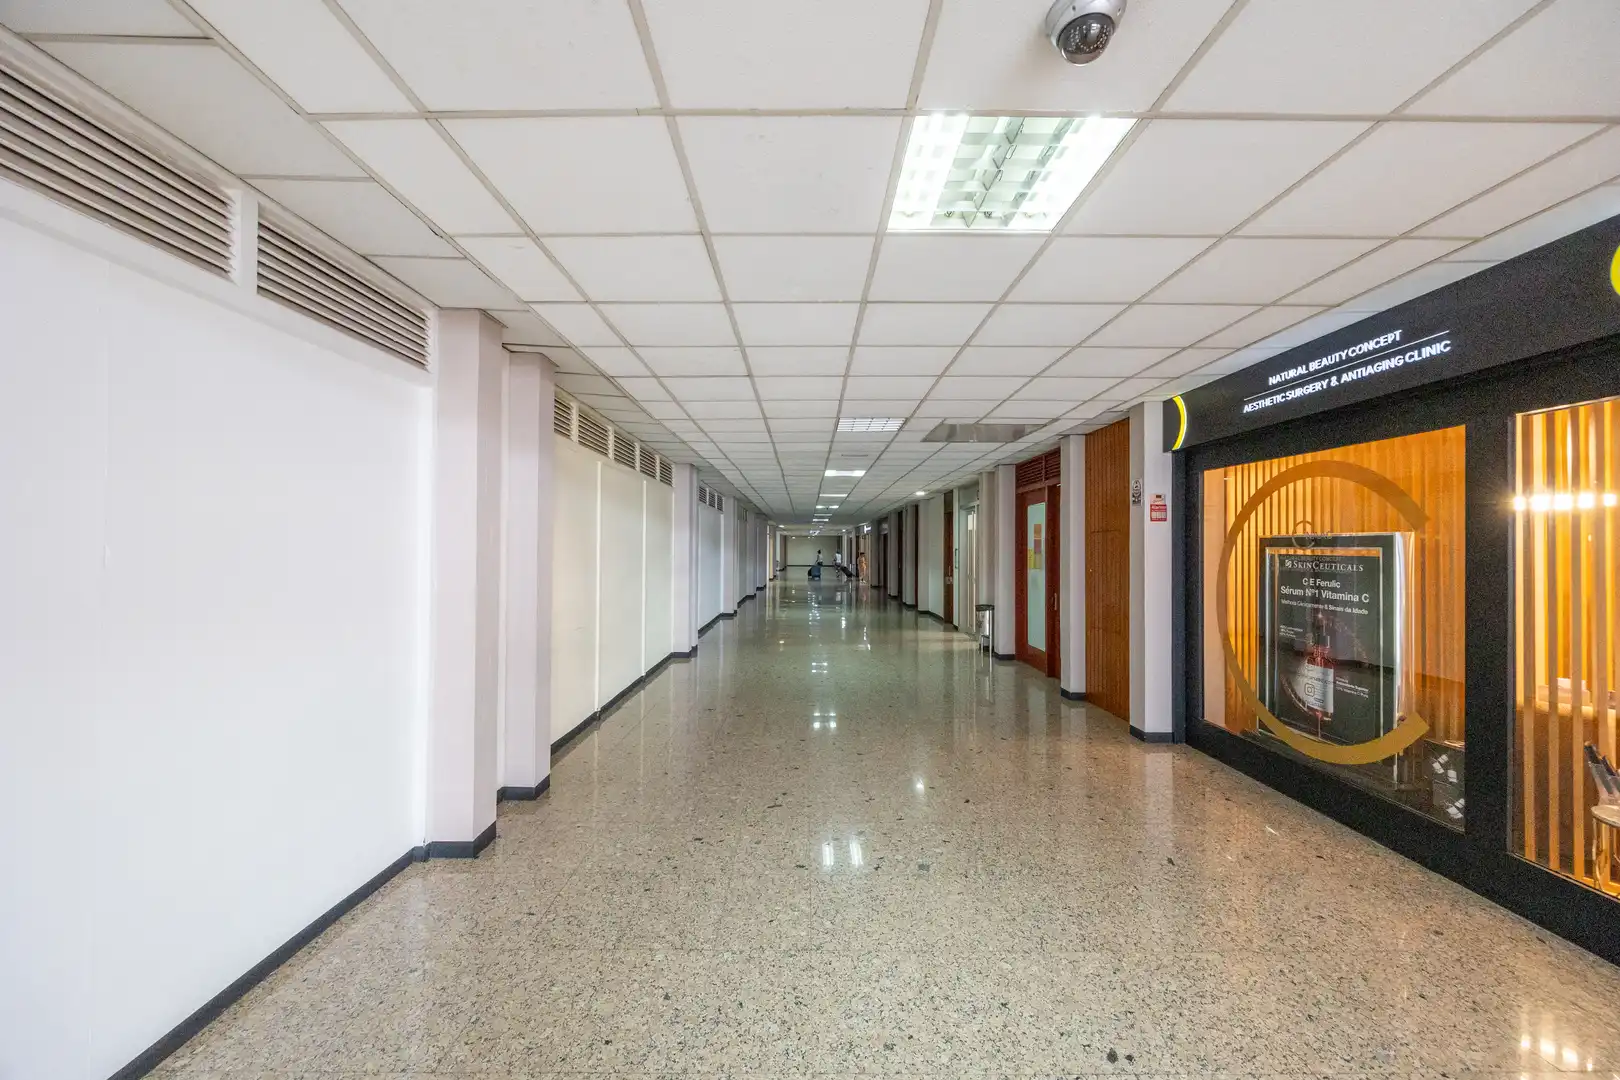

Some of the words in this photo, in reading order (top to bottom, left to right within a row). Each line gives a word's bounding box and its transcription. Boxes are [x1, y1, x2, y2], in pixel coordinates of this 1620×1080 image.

[1268, 365, 1308, 386] NATURAL
[1308, 348, 1349, 372] BEAUTY
[1347, 329, 1403, 357] CONCEPT
[1243, 393, 1286, 414] AESTHETIC
[1285, 378, 1329, 401] SURGERY
[1330, 375, 1339, 387] &
[1340, 354, 1404, 384] ANTIAGING
[1404, 339, 1451, 364] CLINIC
[1280, 585, 1304, 596] Sérum
[1320, 589, 1359, 602] Vitamina
[1361, 593, 1370, 603] C
[1302, 577, 1309, 586] C
[1309, 578, 1315, 586] E
[1316, 578, 1341, 588] Ferulic
